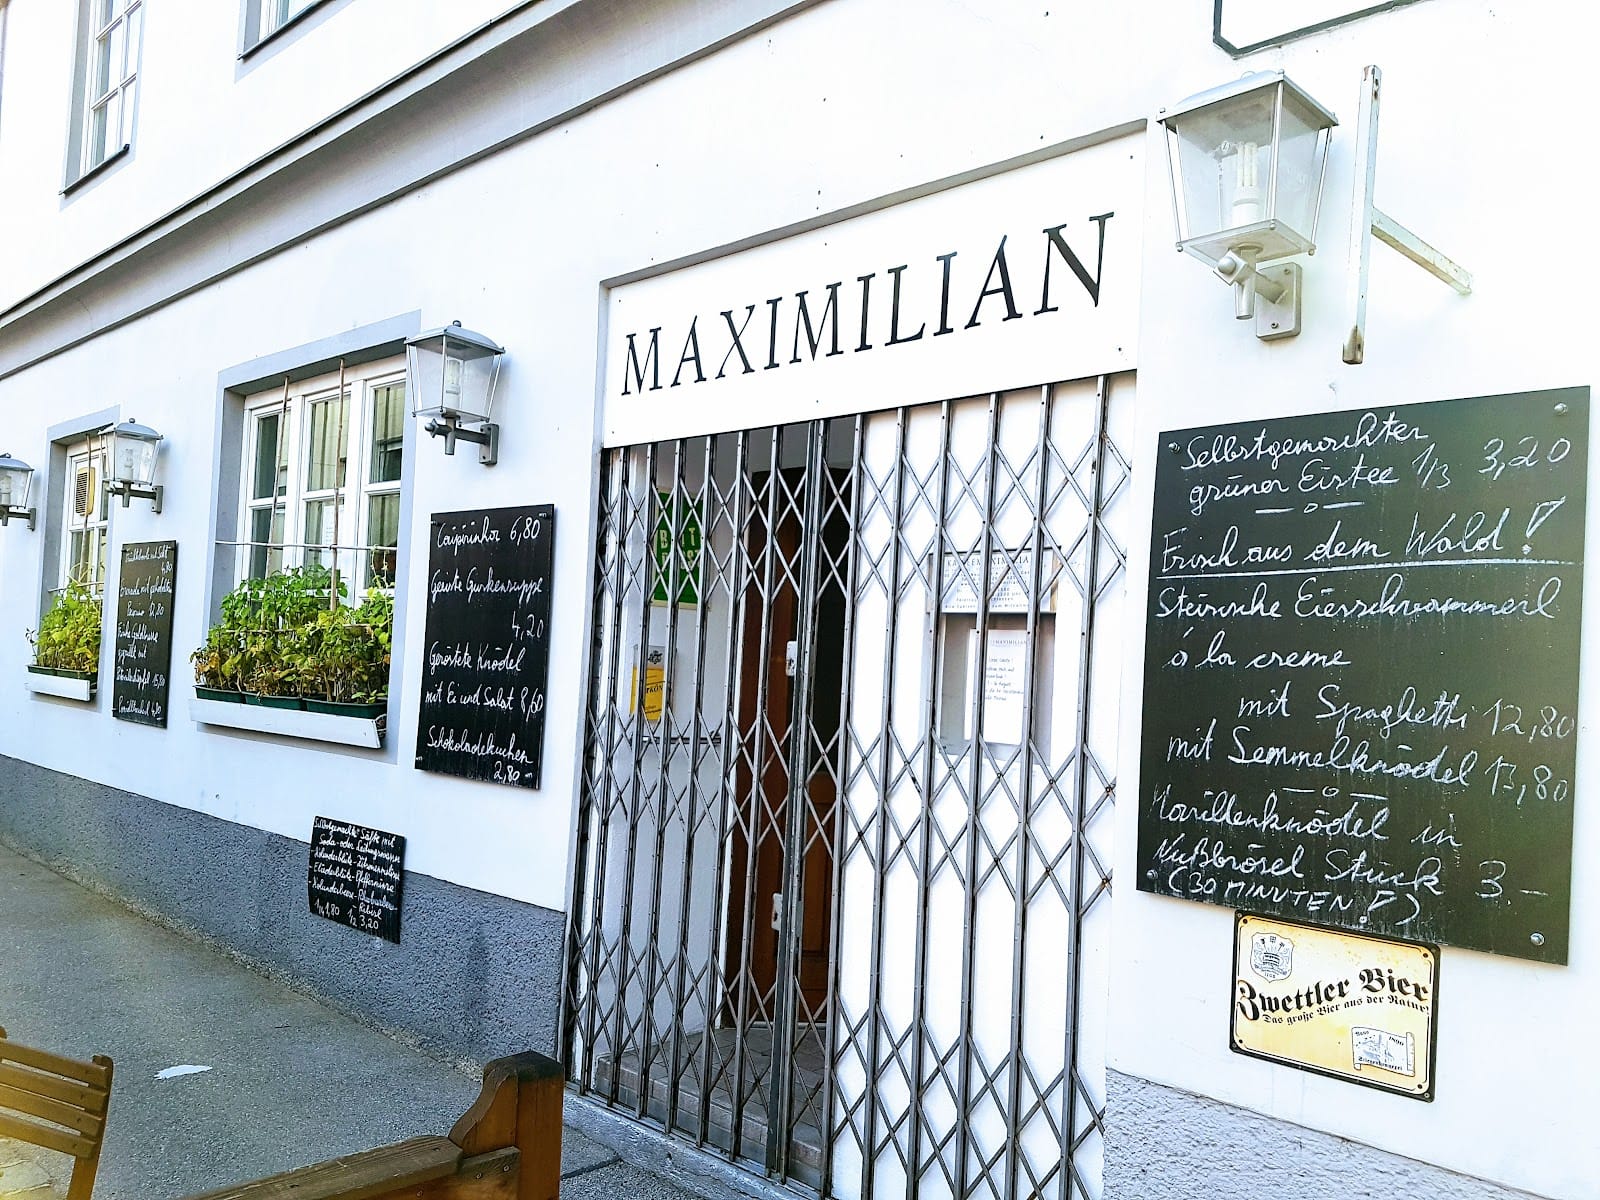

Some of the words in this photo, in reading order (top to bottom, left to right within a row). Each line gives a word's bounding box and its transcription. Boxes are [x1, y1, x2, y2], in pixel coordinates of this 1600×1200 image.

[621, 211, 1115, 395] MAXIMILIAN
[1181, 411, 1429, 471] Selbstgemachter
[1189, 474, 1289, 516] grüner
[1299, 454, 1401, 492] Eistee
[1411, 443, 1451, 490] 1/3
[1478, 436, 1571, 481] 3,20
[437, 515, 501, 556] Caipirinha
[510, 516, 541, 546] 6,80
[1162, 525, 1240, 573] Frisch
[1248, 546, 1293, 564] aus
[1303, 520, 1391, 561] dem
[466, 566, 544, 608] Gurkensuppe
[1154, 583, 1282, 619] Steirische
[512, 610, 544, 641] 4,20
[429, 641, 473, 676] Geröstete
[476, 642, 526, 673] Knödel
[1206, 630, 1237, 667] la
[1245, 648, 1351, 670] creme
[425, 681, 444, 704] mit
[447, 682, 460, 704] Ei
[460, 684, 480, 706] und
[483, 684, 514, 711] Salat
[520, 687, 544, 722] 8,60
[1238, 680, 1292, 719] mit
[1315, 684, 1467, 740] Spaghetti
[1481, 698, 1576, 744] 12,80
[493, 760, 520, 782] 2,80
[1166, 718, 1217, 763] mit
[1227, 725, 1477, 787] Semmelknödel
[381, 835, 396, 848] mit
[1411, 820, 1463, 848] in
[1324, 848, 1445, 897] Stück
[1224, 880, 1354, 913] MINUTEN
[360, 915, 379, 930] 3,20
[1237, 978, 1350, 1021] Zwettler
[1359, 967, 1429, 1001] Bier
[1262, 1013, 1284, 1024] Das
[1286, 1012, 1314, 1026] große
[1317, 1002, 1341, 1017] Bier
[1343, 997, 1363, 1009] aus
[1366, 994, 1384, 1004] der
